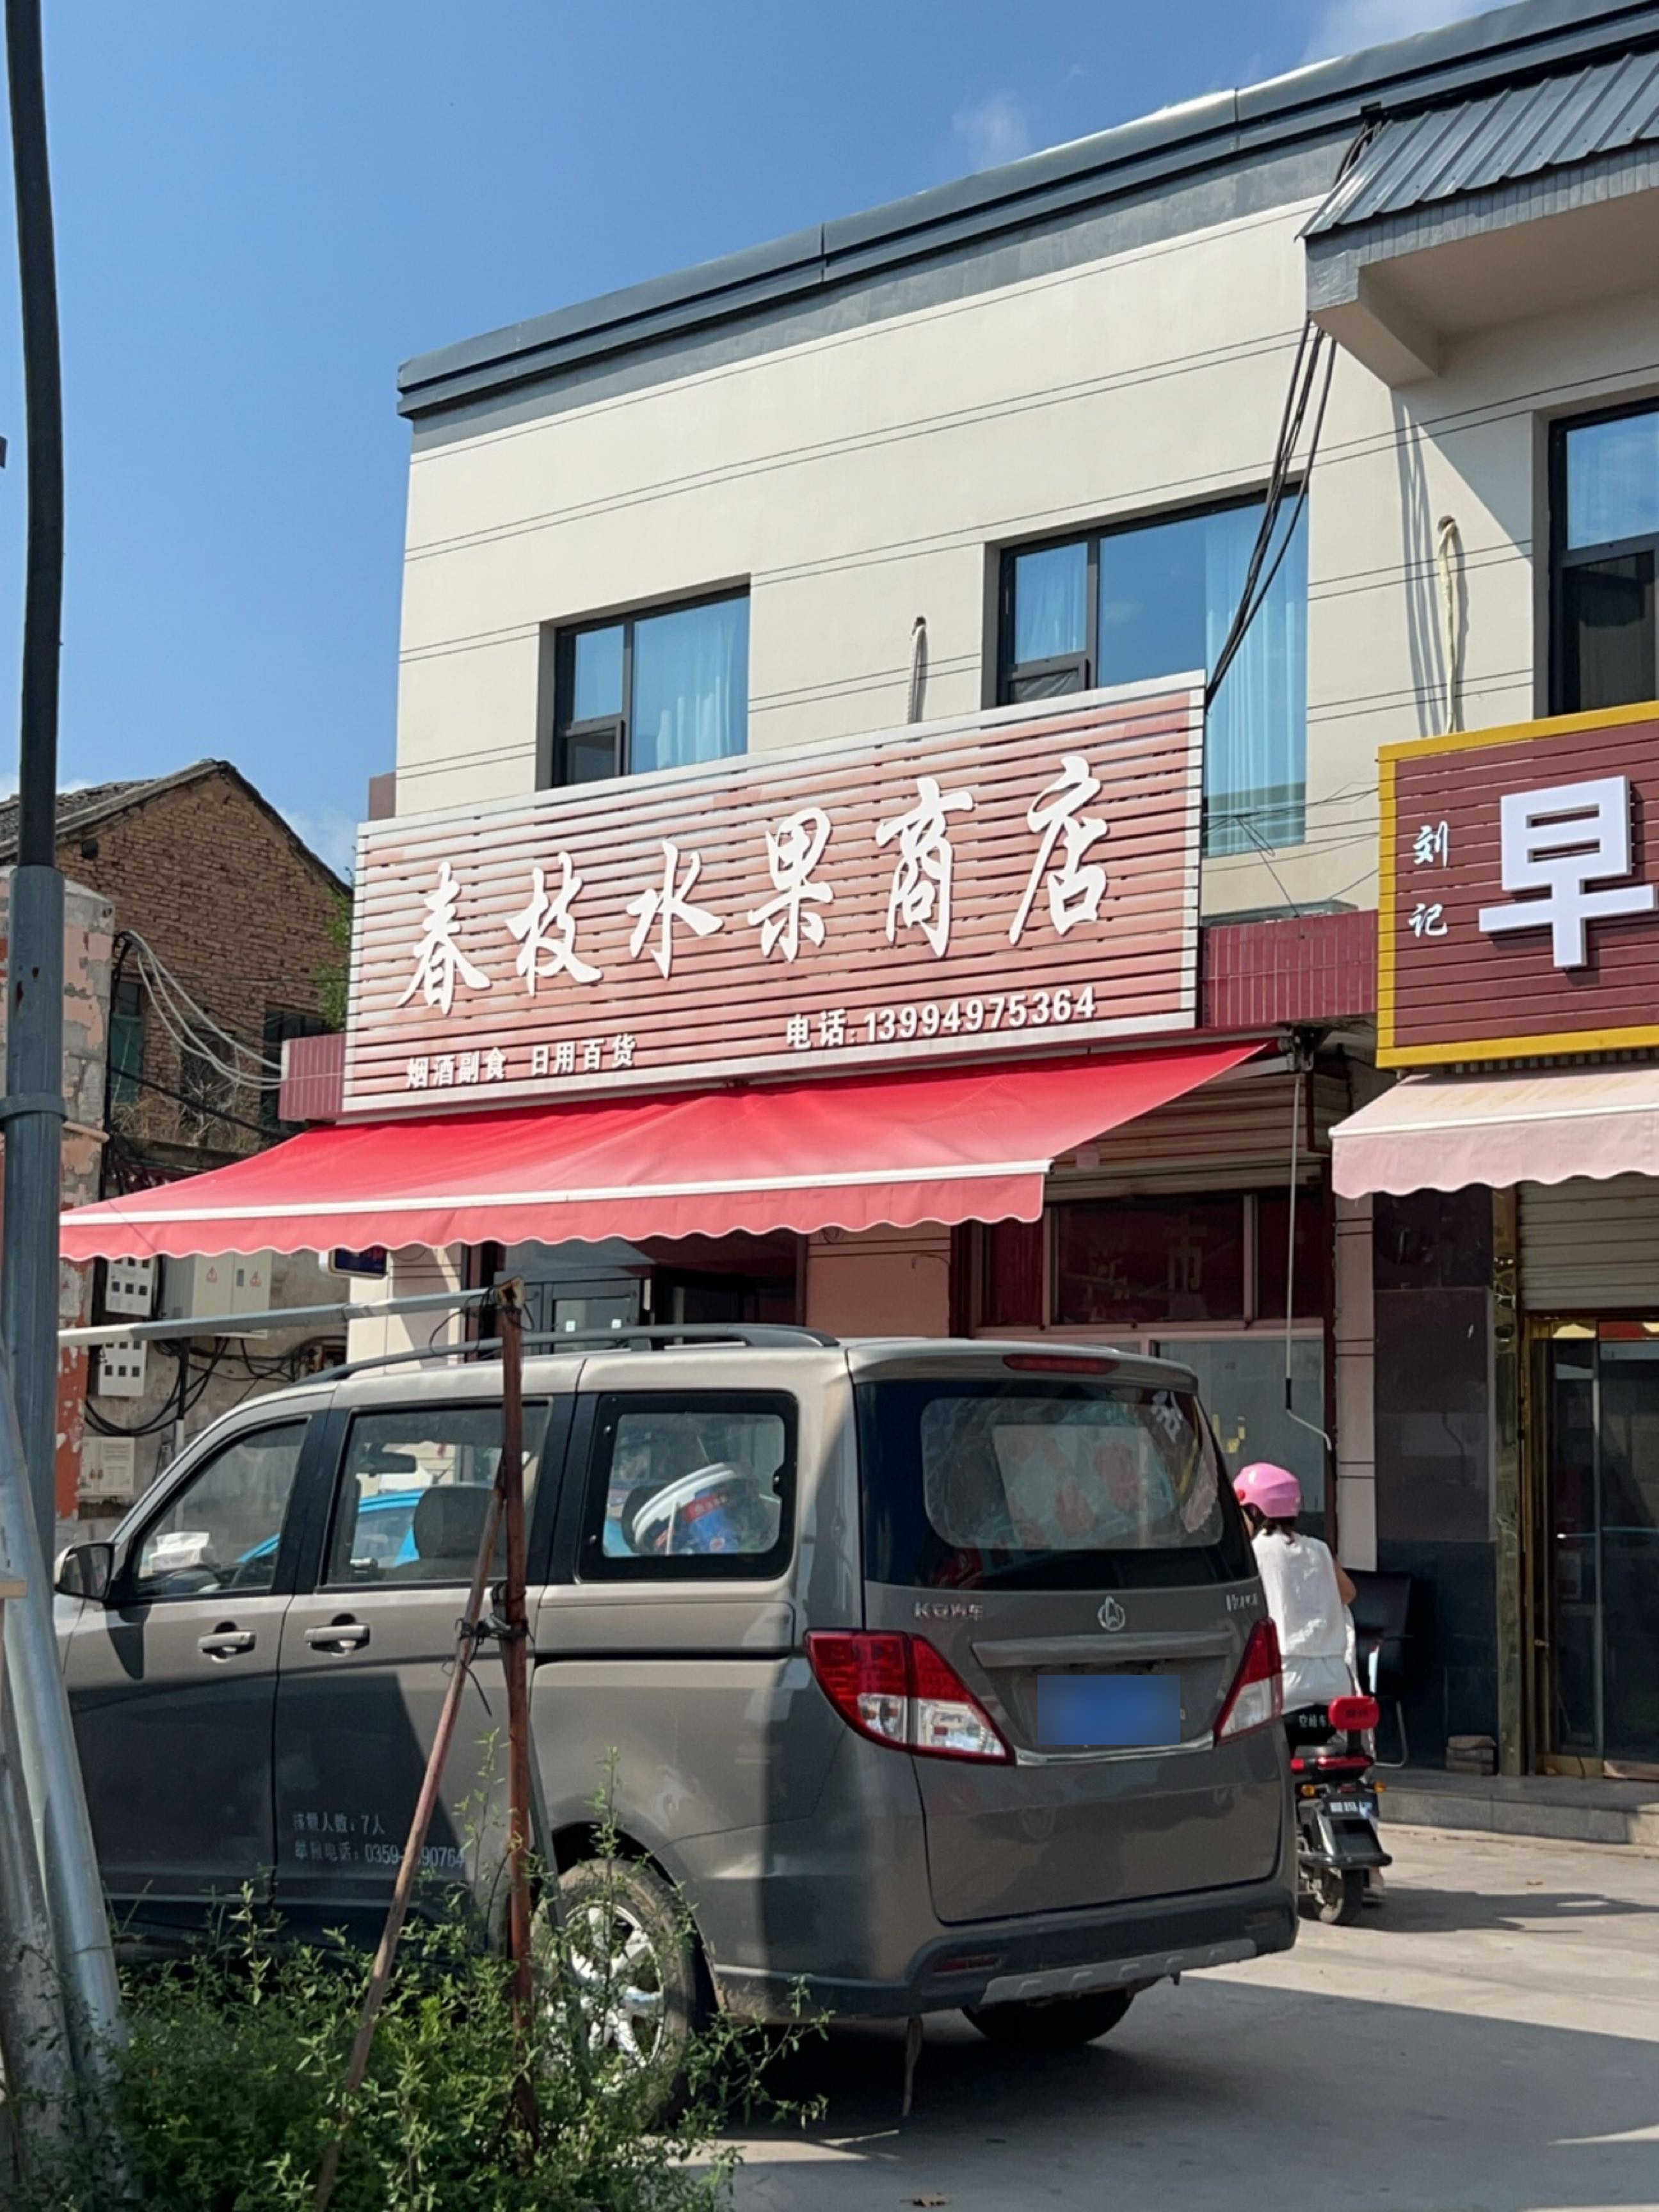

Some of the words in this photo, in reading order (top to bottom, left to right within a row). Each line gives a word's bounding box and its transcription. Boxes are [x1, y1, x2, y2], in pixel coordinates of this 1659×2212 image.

[397, 755, 1109, 1016] 春枝水果商店
[1408, 819, 1449, 938] 刘记
[1479, 776, 1656, 968] 早
[405, 1046, 508, 1091] 烟酒副食
[530, 1034, 637, 1077] 日用百货
